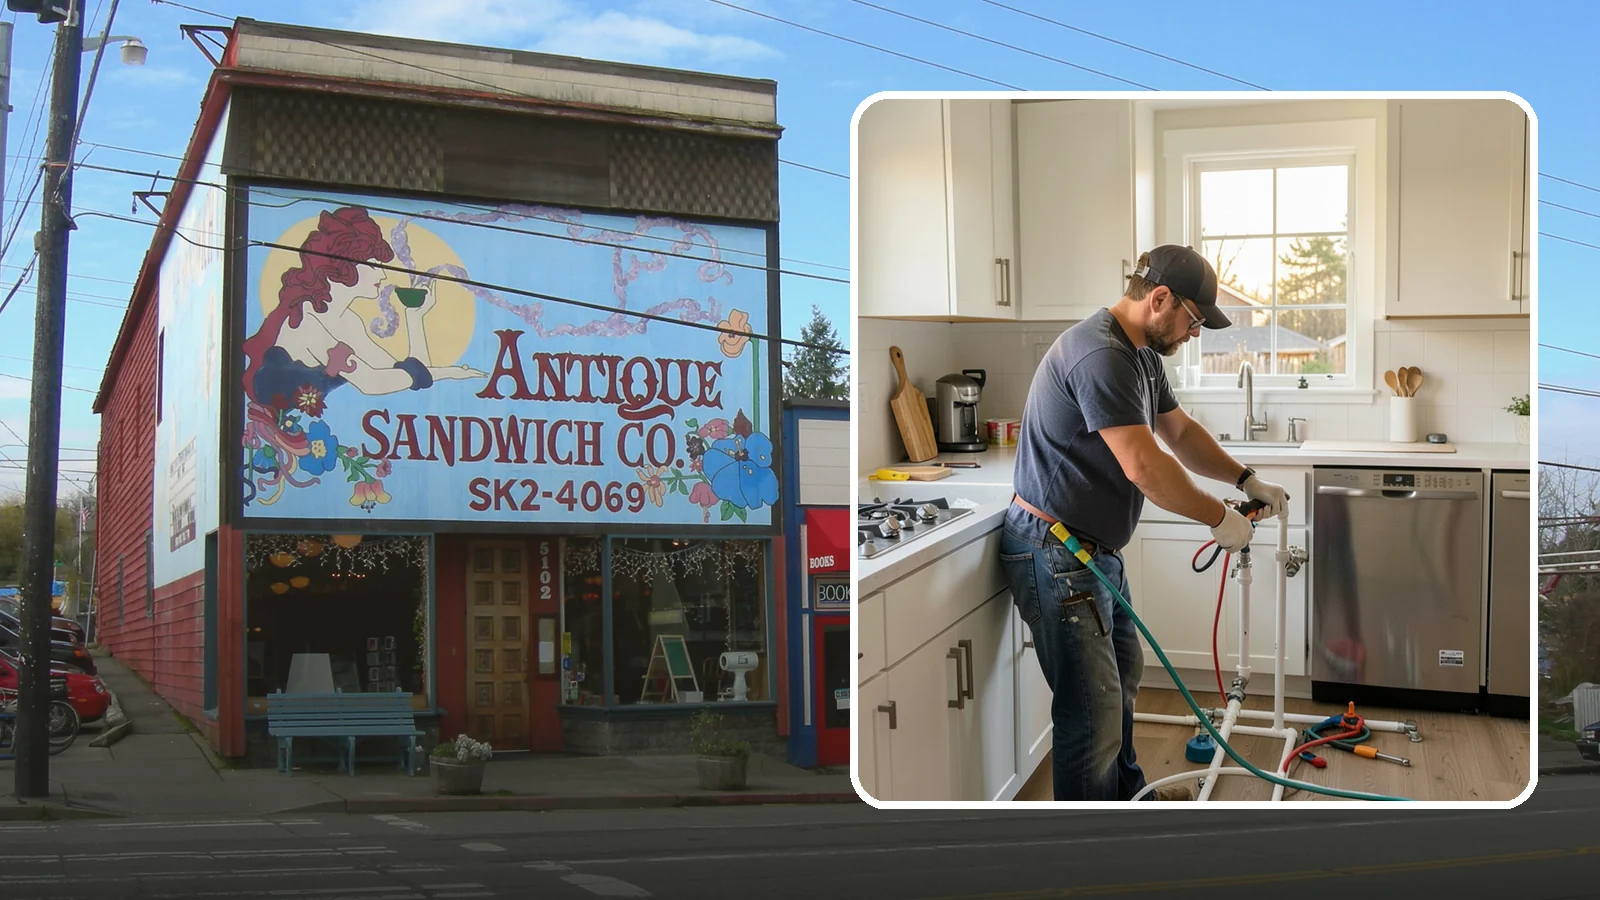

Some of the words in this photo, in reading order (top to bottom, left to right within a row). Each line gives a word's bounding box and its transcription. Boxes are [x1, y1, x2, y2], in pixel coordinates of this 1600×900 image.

[476, 329, 723, 420] ANTIQUE
[361, 409, 604, 467] SANDWICH
[617, 422, 685, 468] CO.
[468, 478, 646, 512] SK2-4069
[540, 542, 551, 600] 5102
[809, 555, 835, 569] BOOKS
